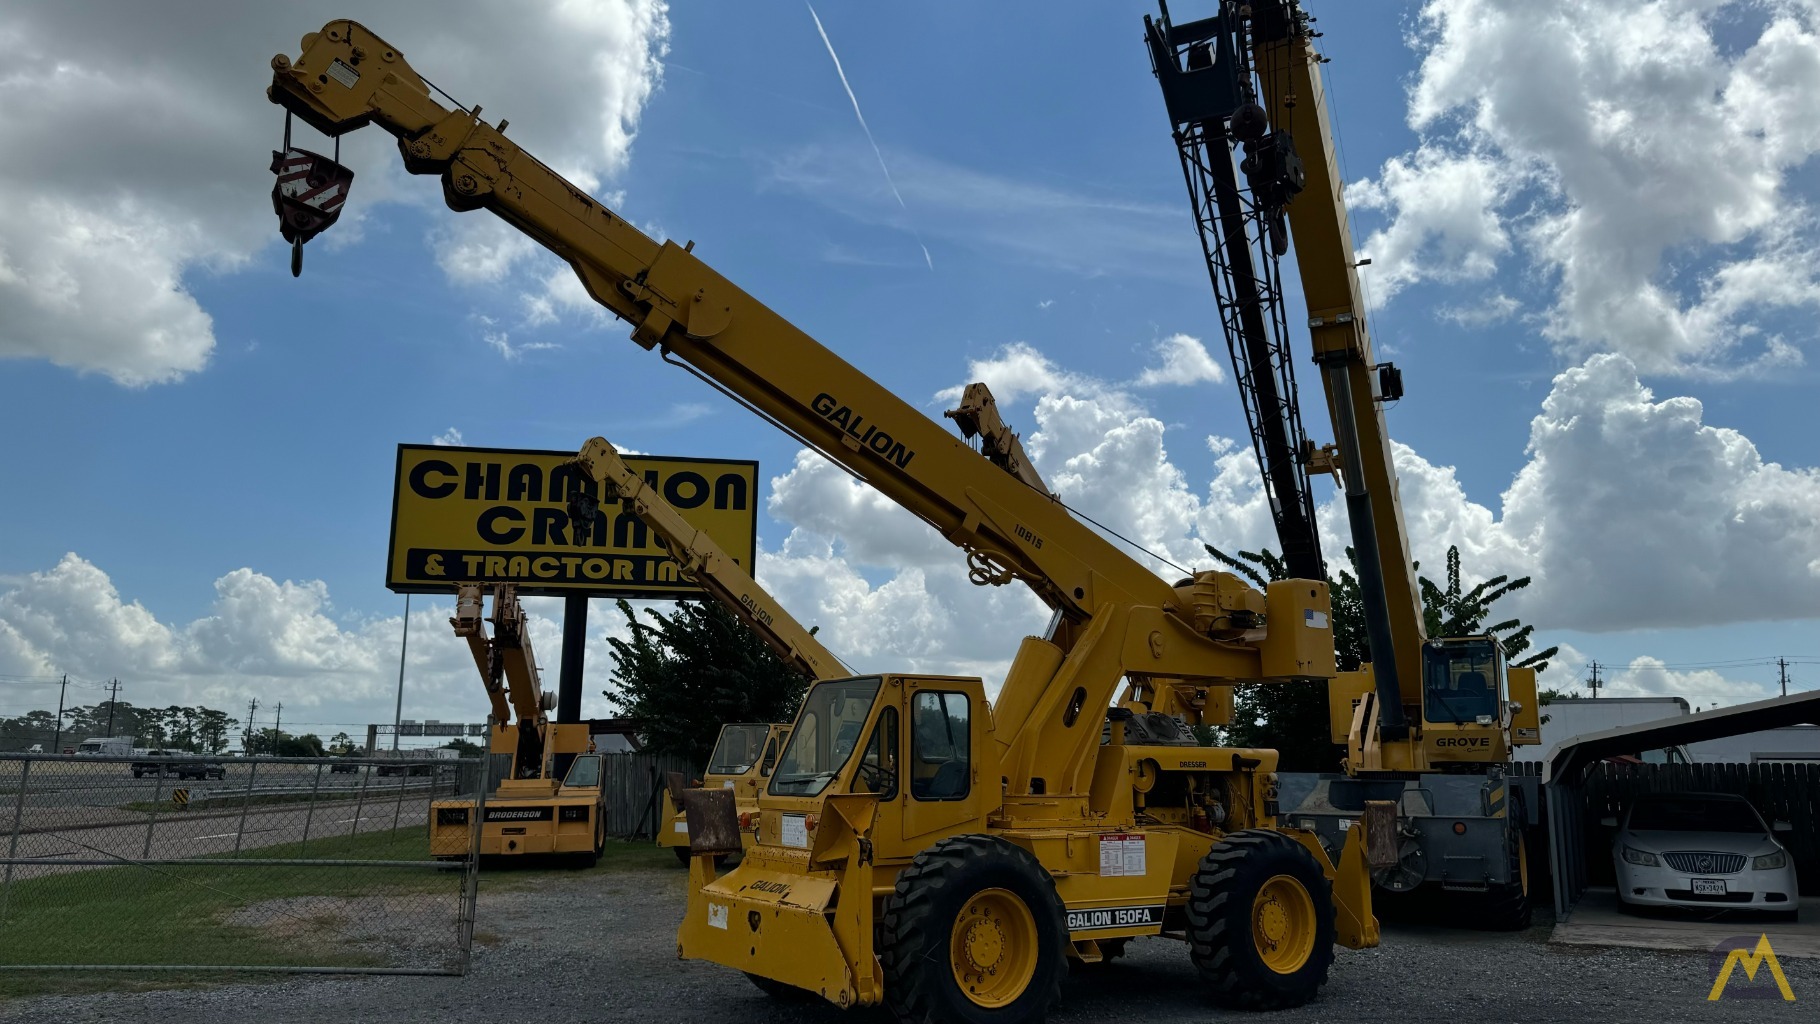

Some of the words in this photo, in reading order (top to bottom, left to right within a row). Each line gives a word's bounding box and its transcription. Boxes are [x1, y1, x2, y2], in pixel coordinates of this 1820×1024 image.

[811, 392, 915, 469] GALION
[409, 459, 747, 510] CHAMION
[1014, 523, 1044, 550] 10815
[424, 554, 446, 576] &
[462, 555, 634, 581] TRACTOR
[645, 560, 702, 584] IN
[740, 593, 774, 626] GALION
[1436, 737, 1490, 747] GROVE
[488, 810, 542, 819] BRODERSON
[750, 880, 790, 895] GALION
[1067, 911, 1112, 928] GALION
[1115, 908, 1152, 925] 150FA
